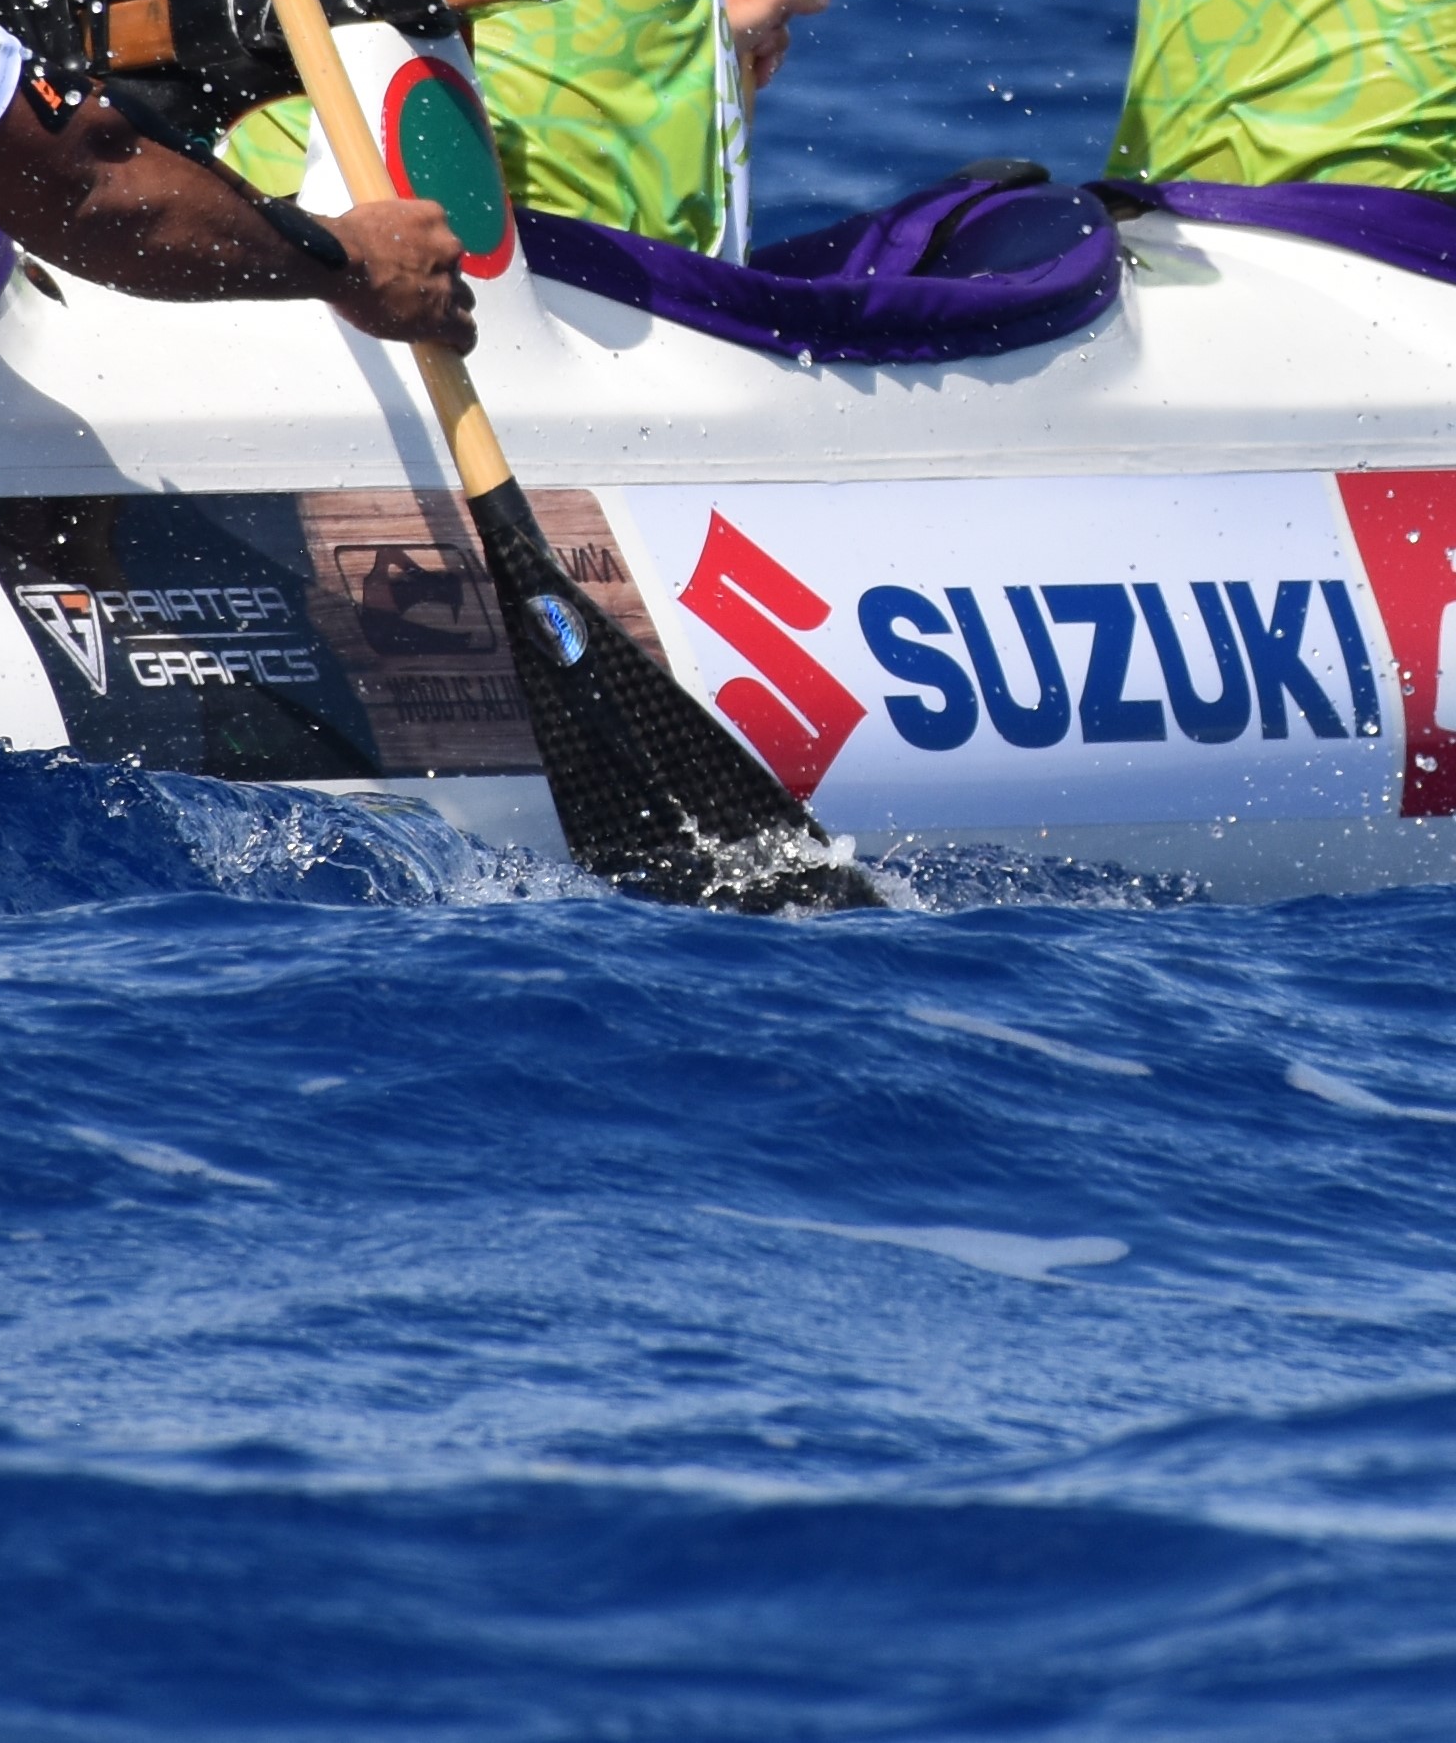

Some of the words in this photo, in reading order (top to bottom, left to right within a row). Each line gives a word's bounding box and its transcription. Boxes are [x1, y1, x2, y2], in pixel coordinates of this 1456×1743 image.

[105, 588, 292, 624] RAIATEA
[129, 650, 321, 687] GRAFICS
[856, 578, 1383, 752] SUZUKI
